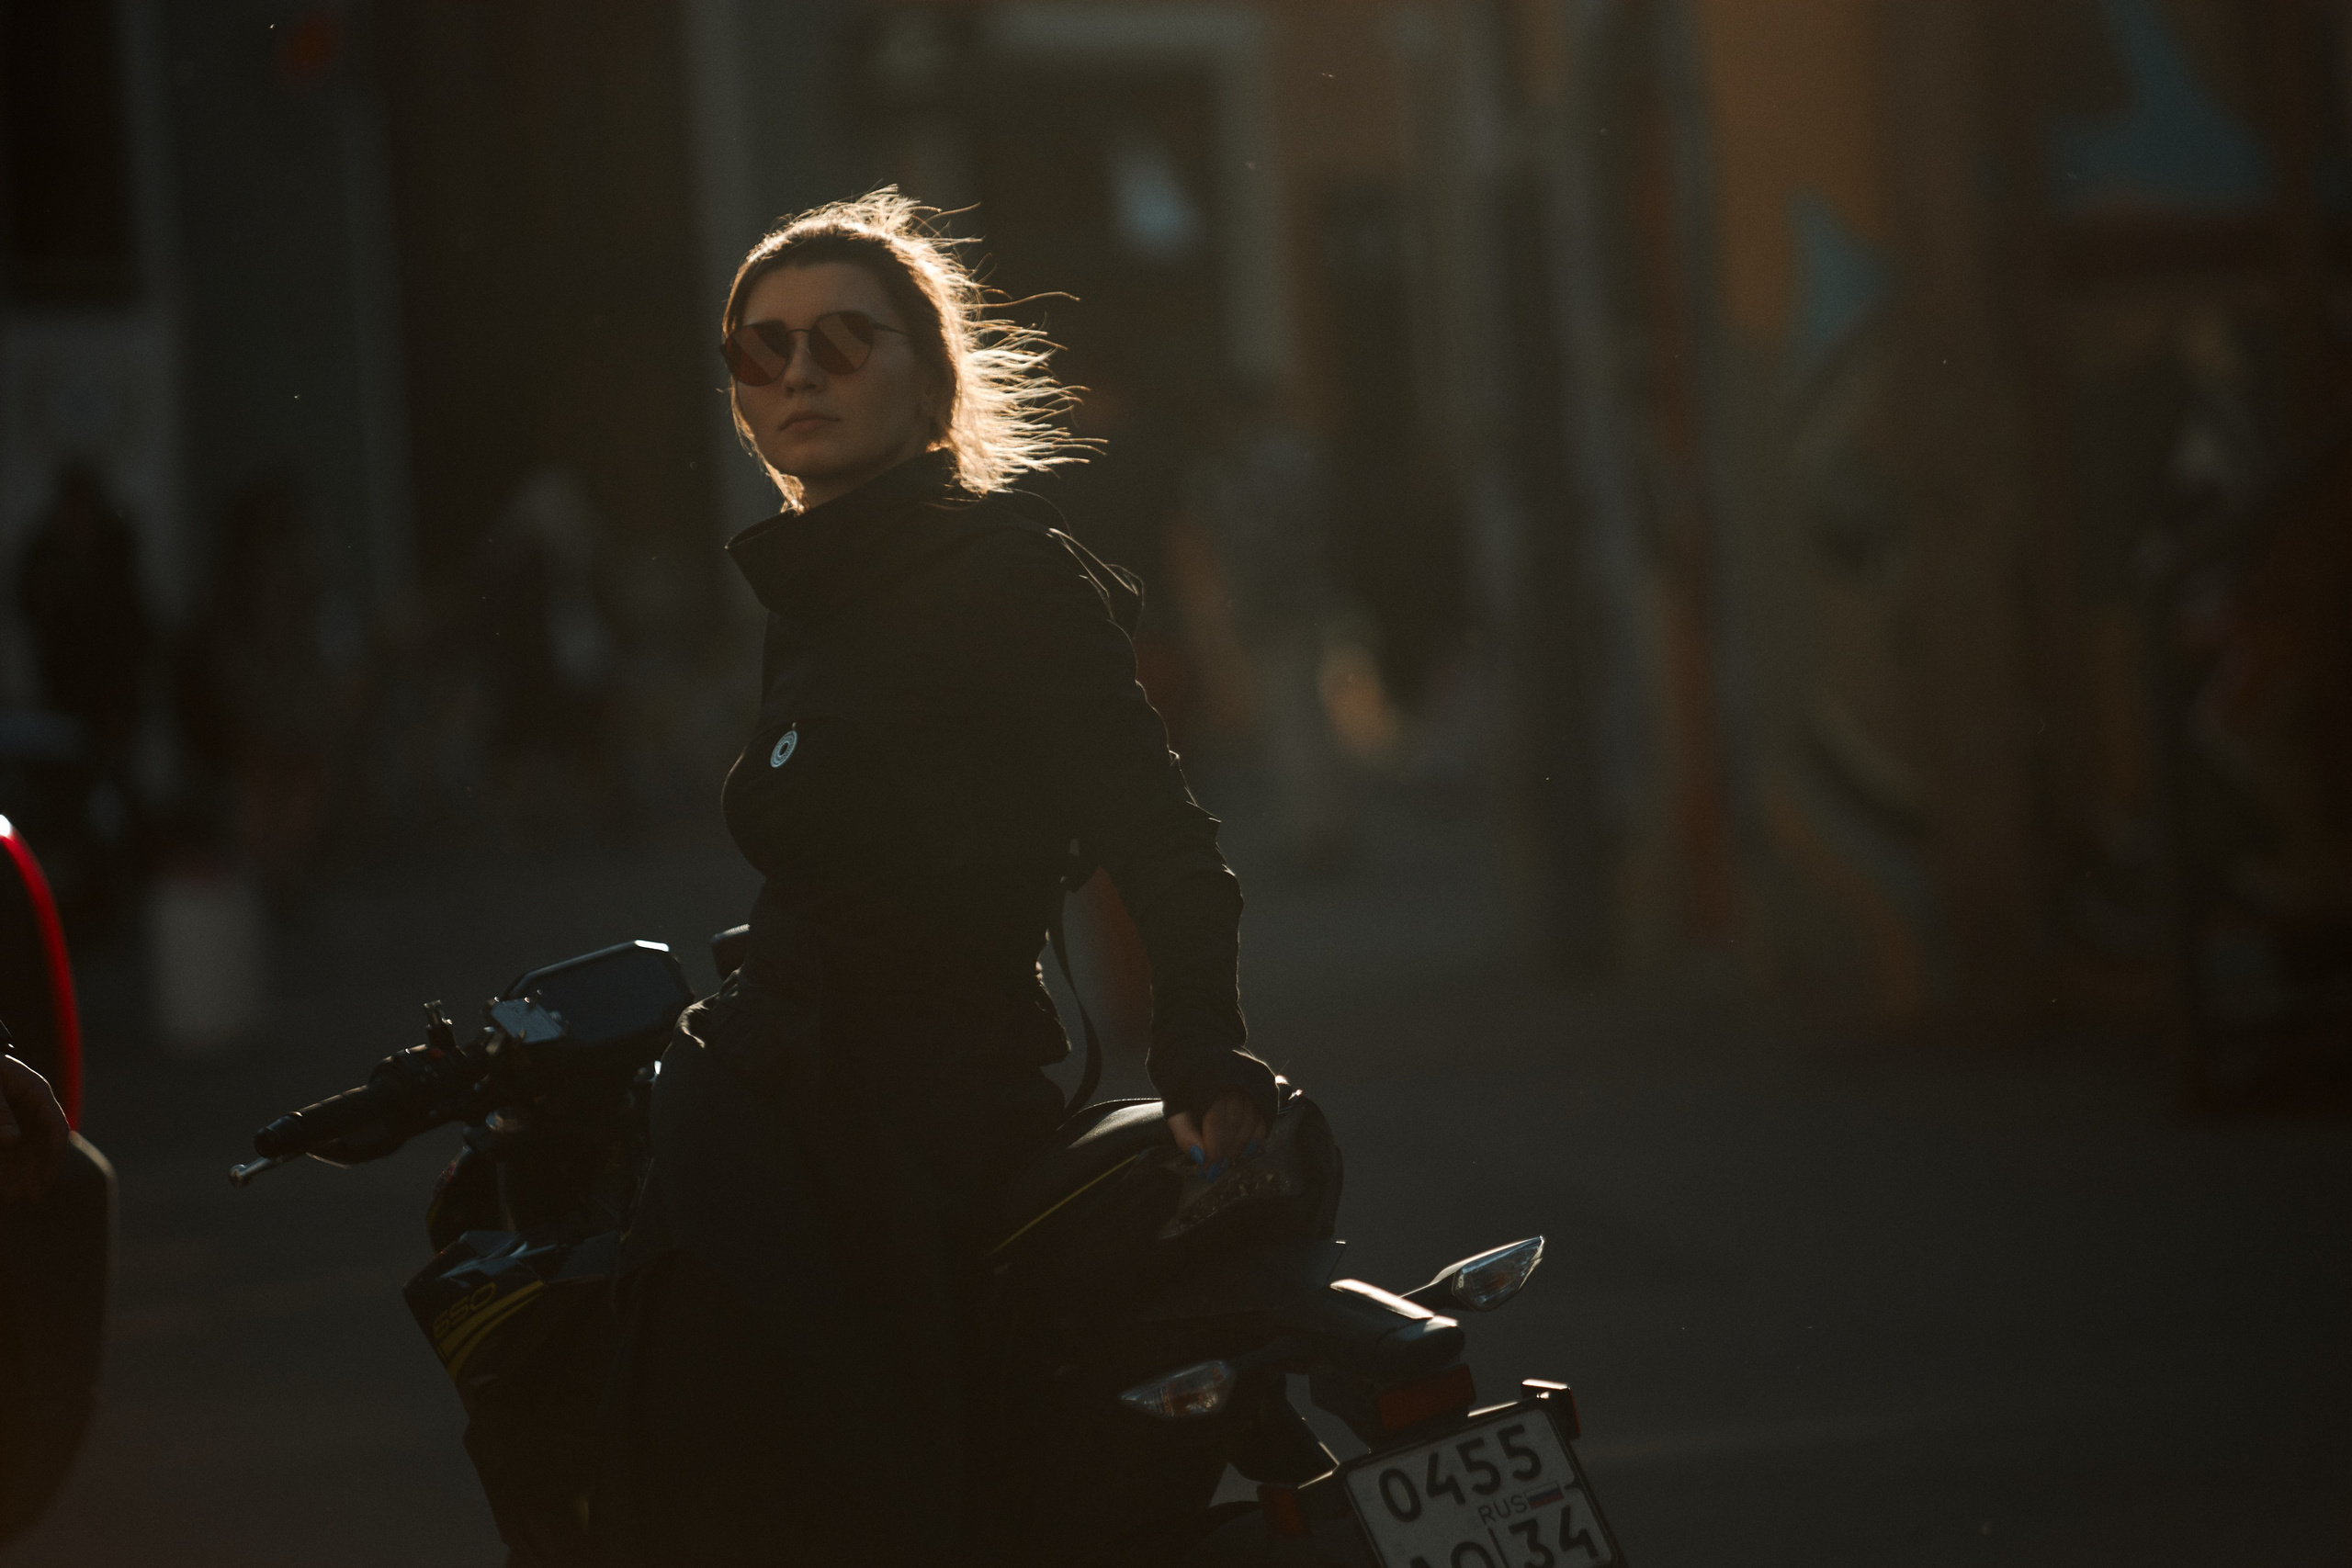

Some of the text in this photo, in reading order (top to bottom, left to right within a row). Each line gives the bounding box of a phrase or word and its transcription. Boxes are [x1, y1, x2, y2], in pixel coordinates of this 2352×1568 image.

[1379, 1424, 1542, 1522] 0455
[1477, 1495, 1528, 1526] RUS
[1509, 1505, 1600, 1568] 34
